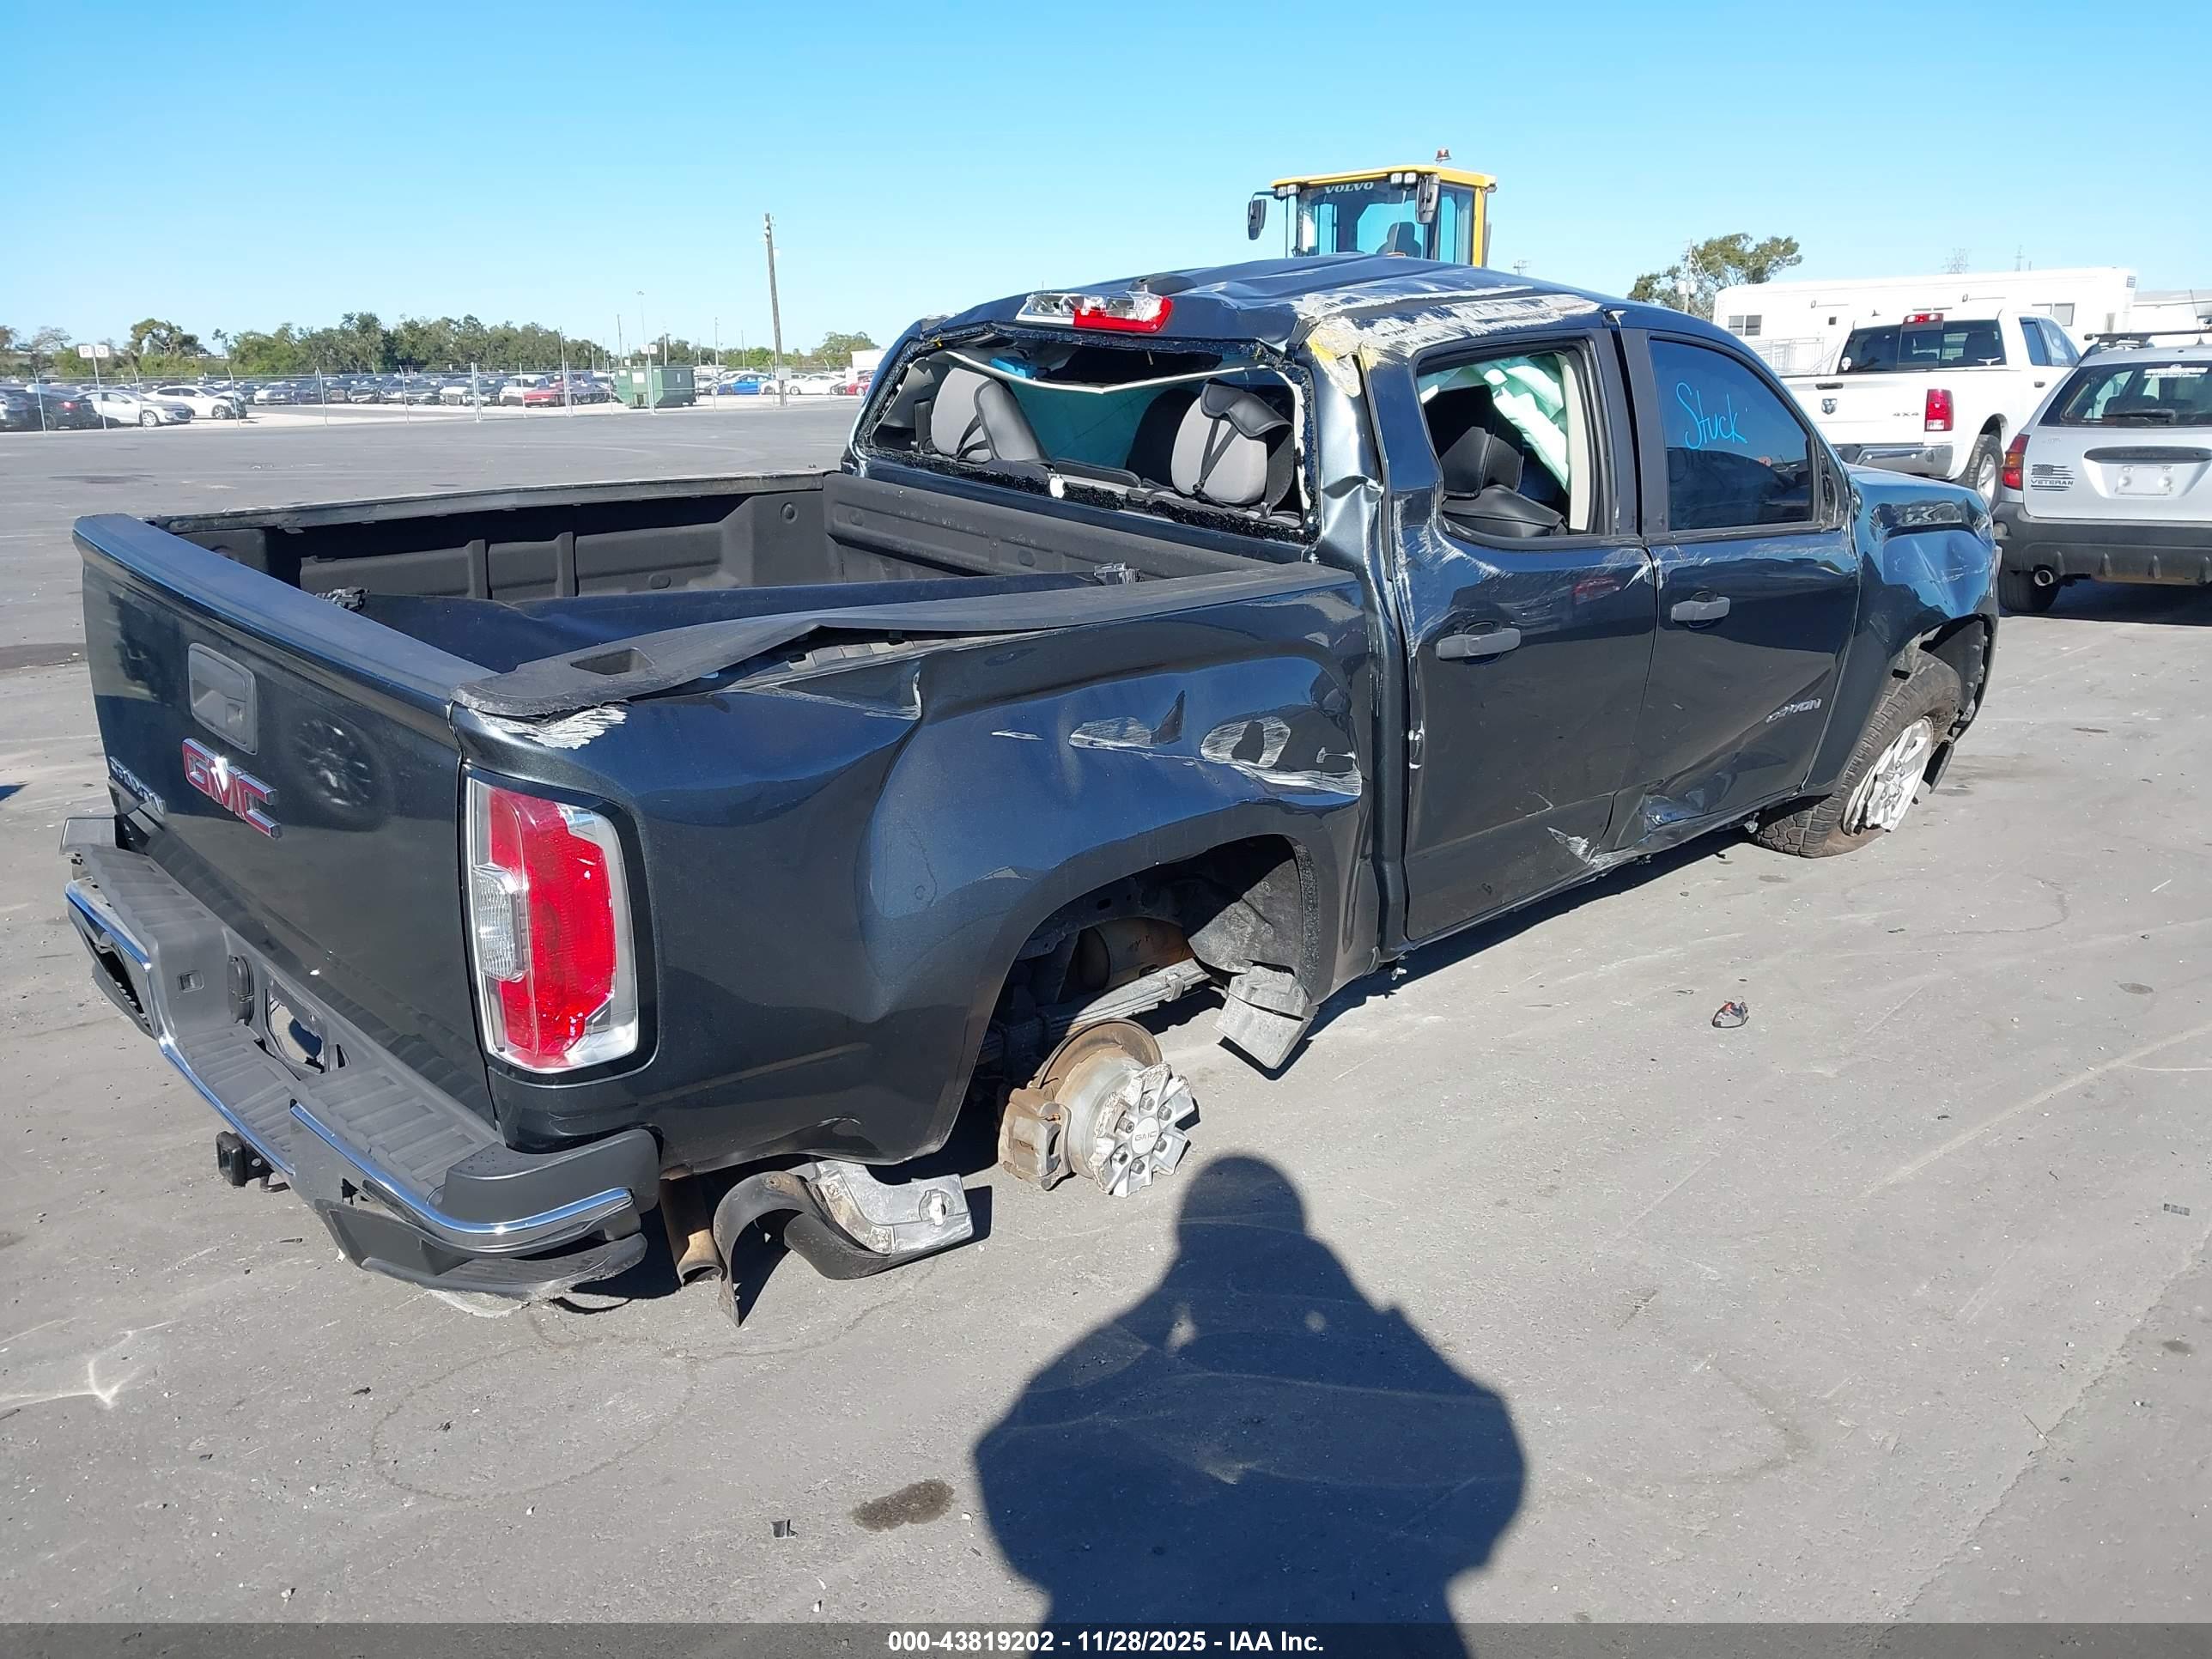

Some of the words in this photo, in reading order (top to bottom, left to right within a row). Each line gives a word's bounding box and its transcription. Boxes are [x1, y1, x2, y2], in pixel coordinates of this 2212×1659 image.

[1325, 181, 1374, 194] VOLVO
[1676, 382, 1748, 449] Stuck
[1765, 698, 1822, 723] CANYON
[182, 738, 283, 840] GMC
[1134, 1130, 1158, 1141] GMC
